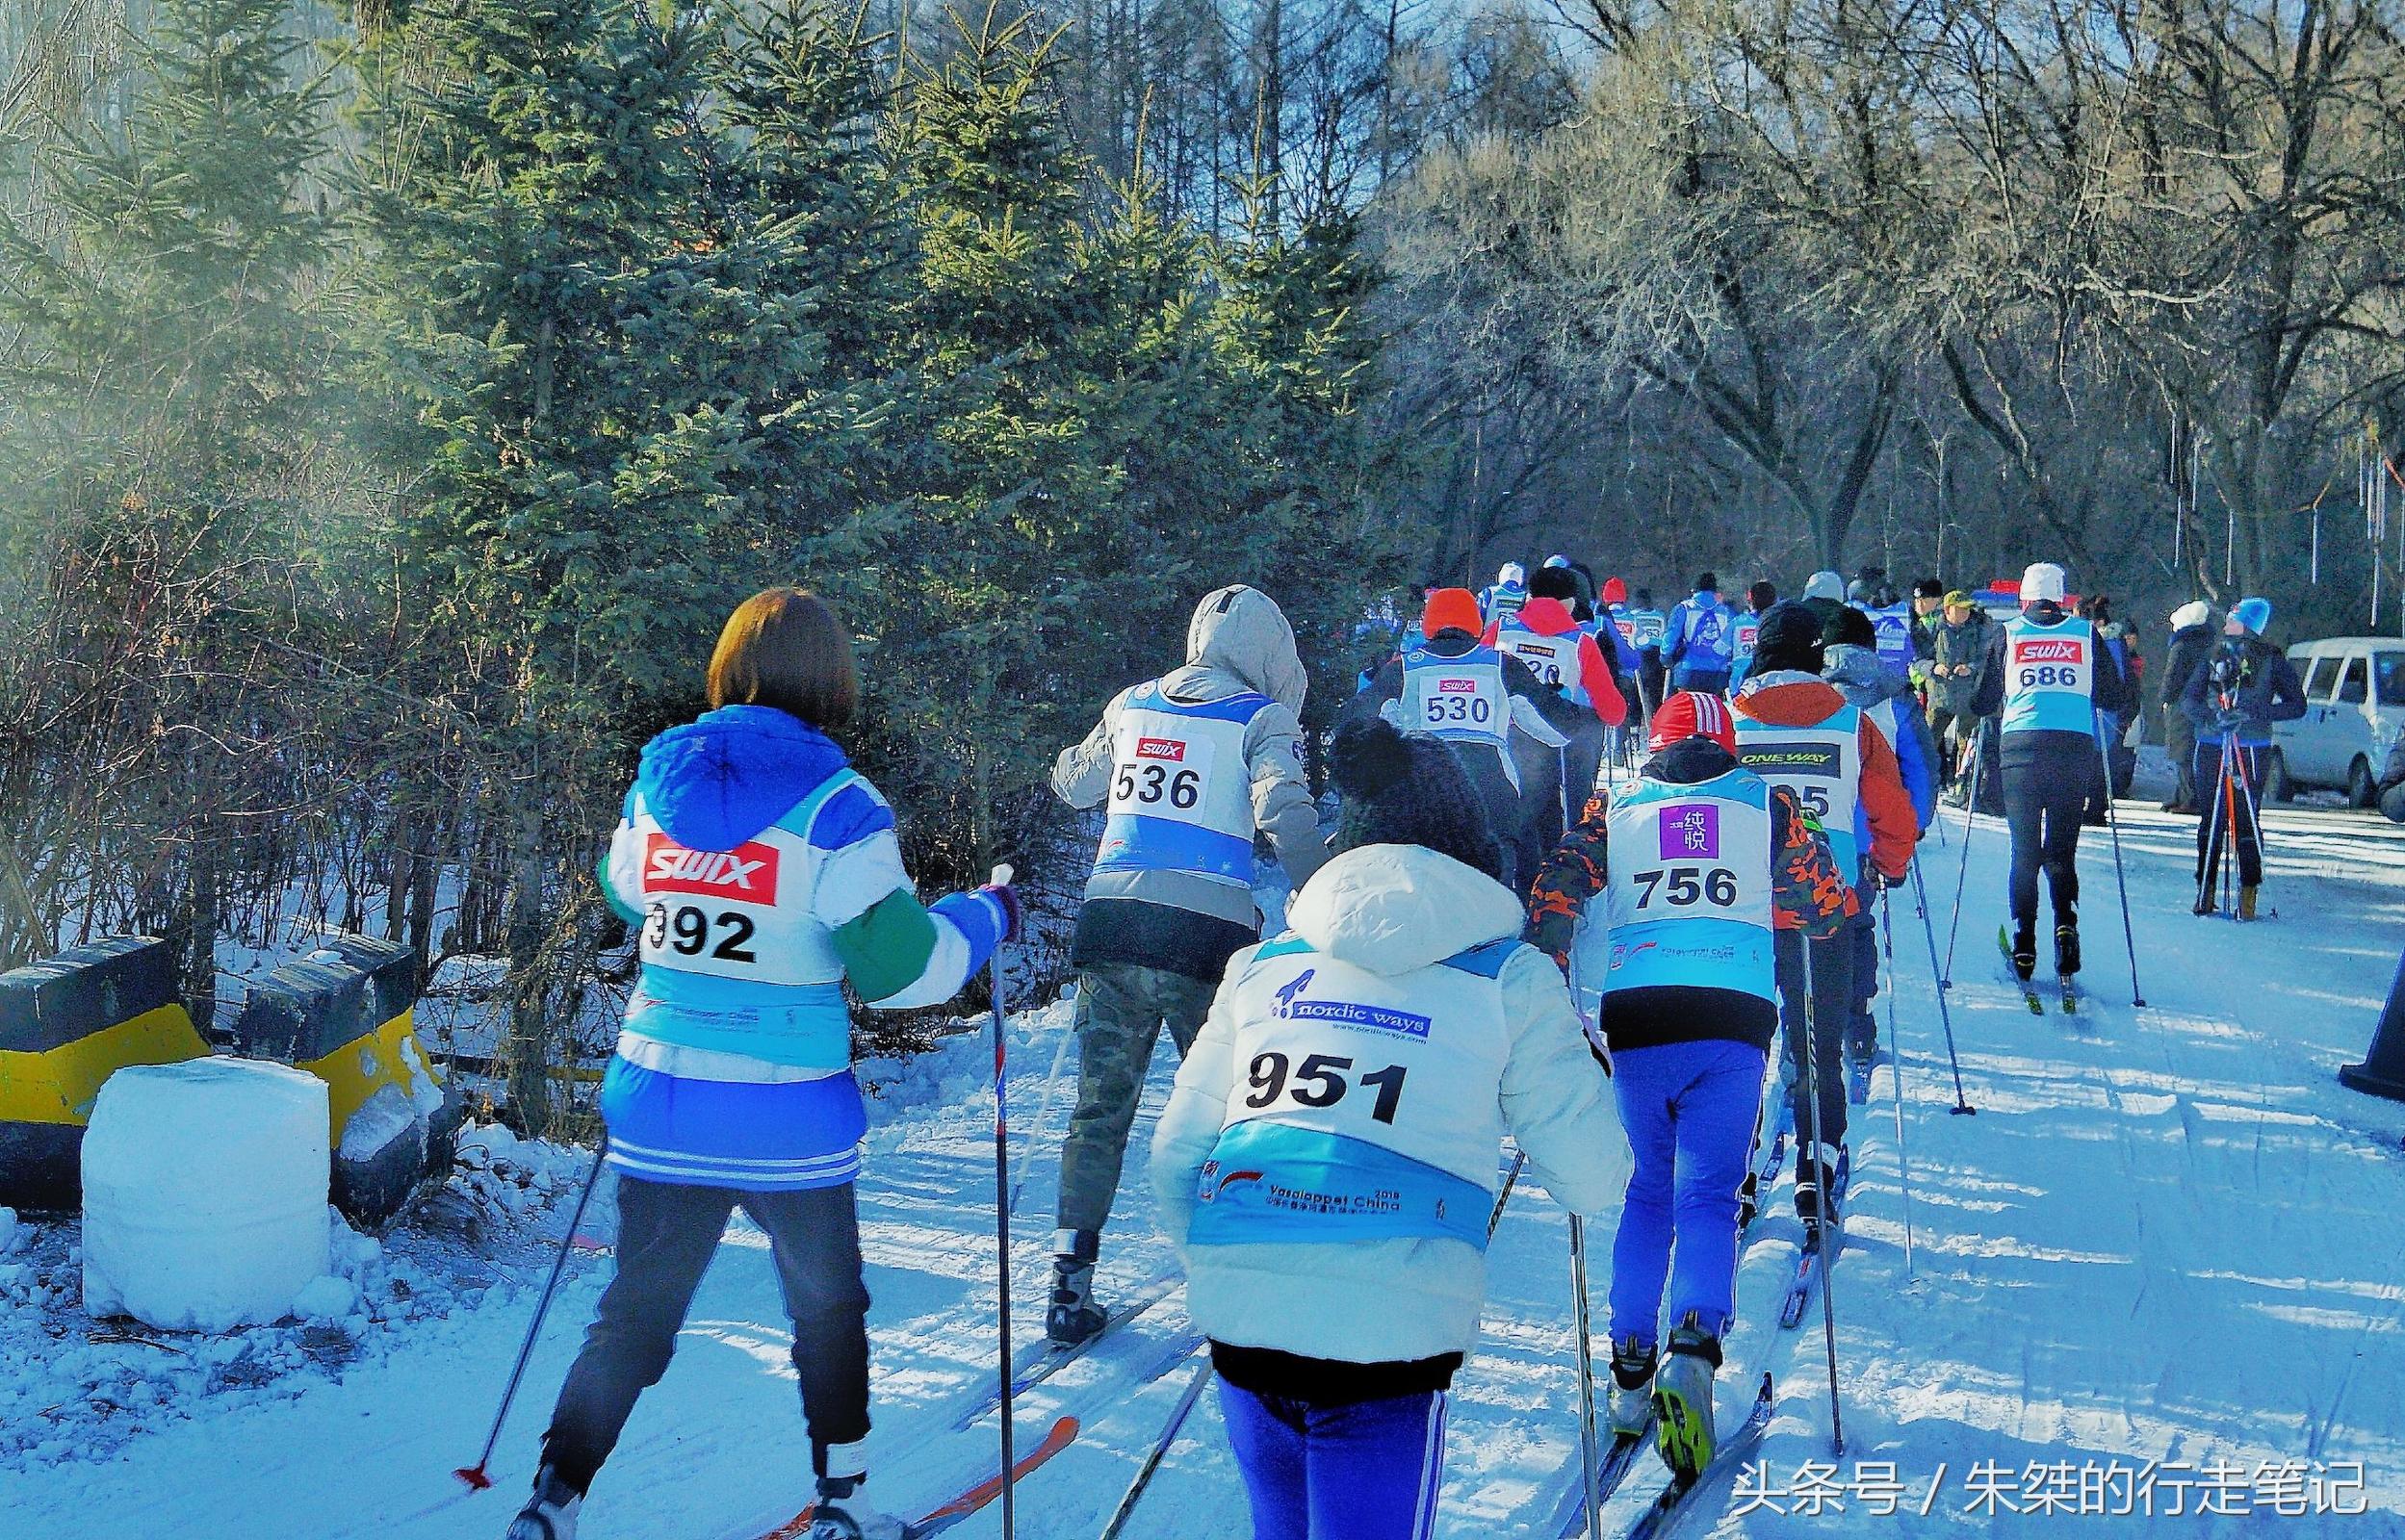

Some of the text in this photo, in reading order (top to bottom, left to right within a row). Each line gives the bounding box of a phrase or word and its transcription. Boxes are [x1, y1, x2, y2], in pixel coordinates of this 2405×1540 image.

[2019, 666, 2077, 687] 686
[1427, 696, 1489, 723] 530
[1116, 763, 1201, 809] 536
[1633, 868, 1738, 910] 756
[649, 903, 758, 964] 392
[1297, 1003, 1425, 1033] nordic ways
[1245, 1052, 1408, 1126] 951
[1354, 1196, 1401, 1211] China
